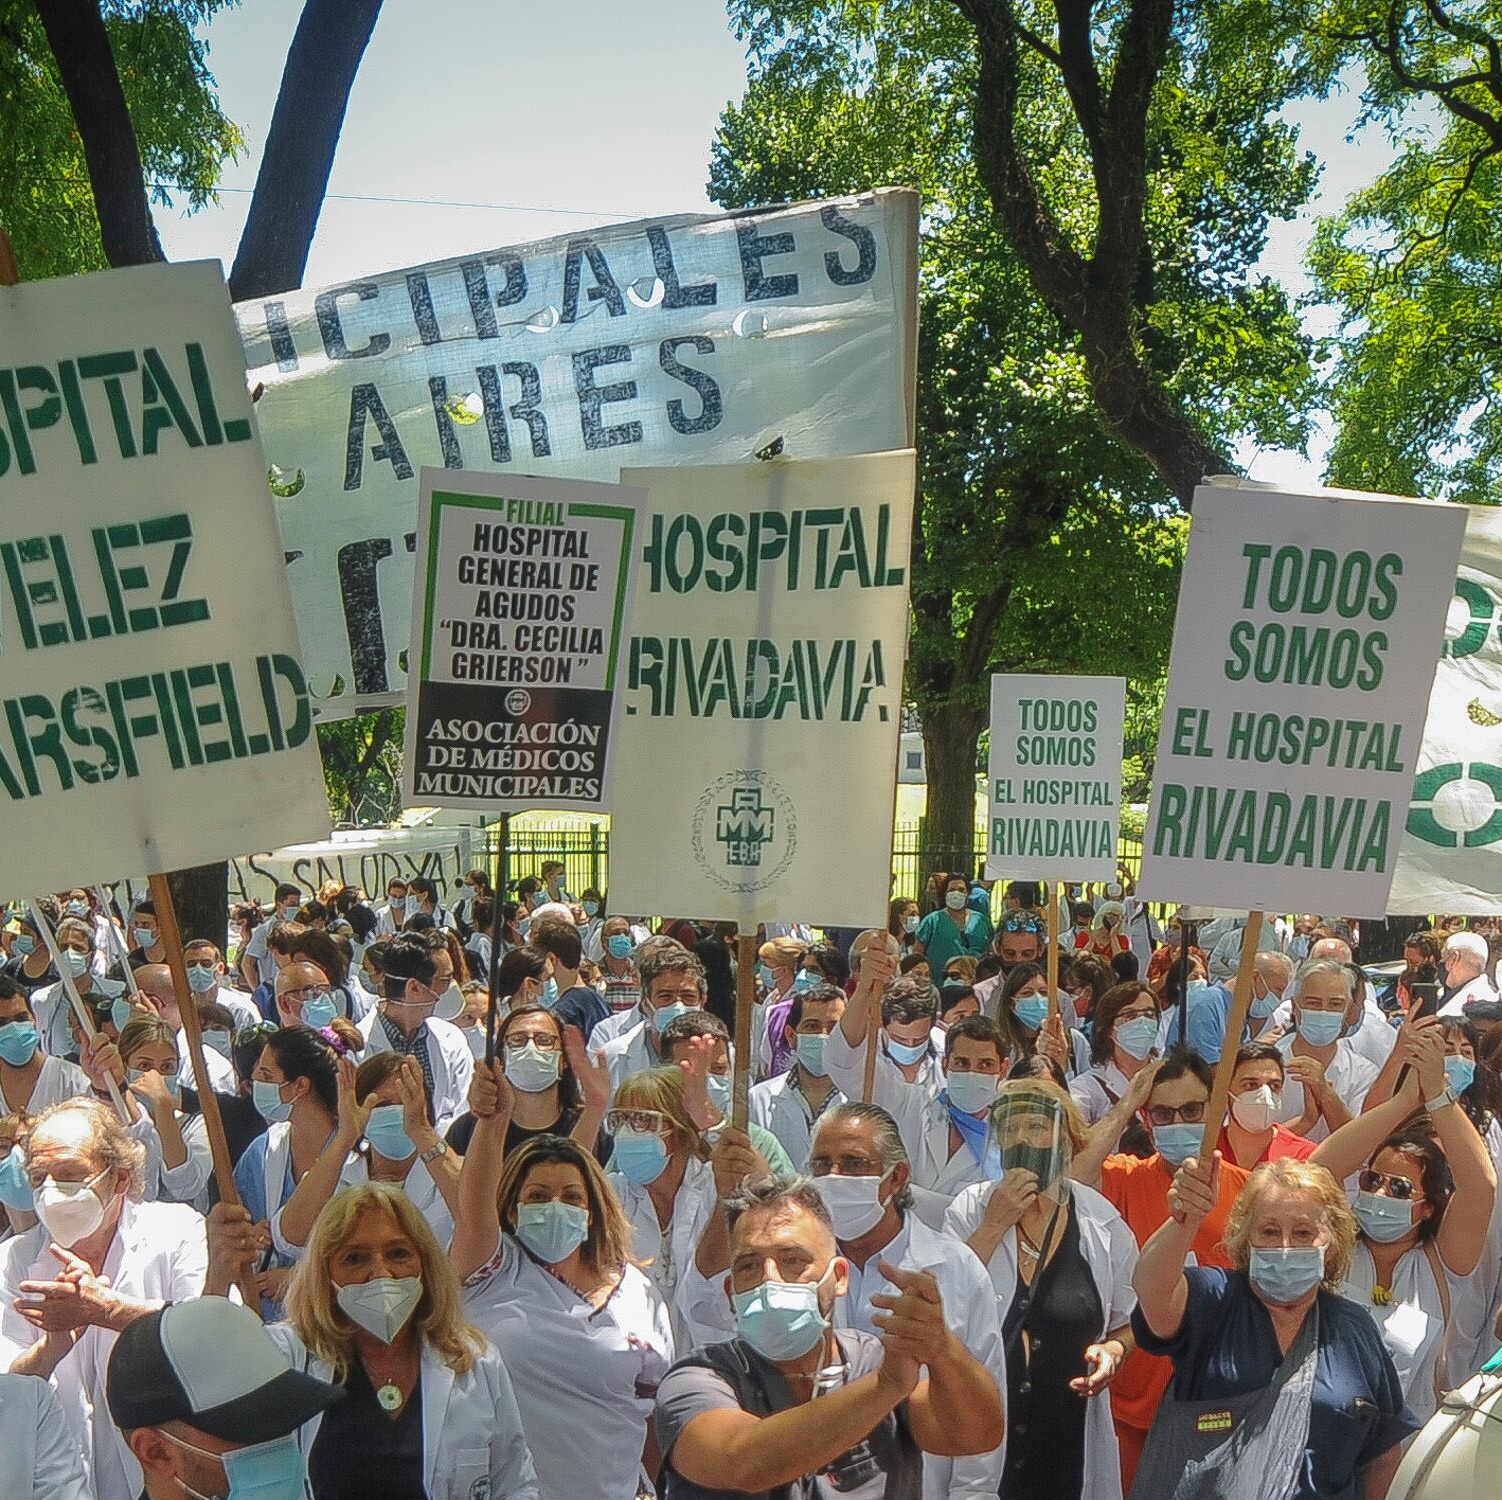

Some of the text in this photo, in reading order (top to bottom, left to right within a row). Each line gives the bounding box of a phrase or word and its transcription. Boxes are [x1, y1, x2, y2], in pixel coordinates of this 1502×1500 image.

[342, 334, 725, 492] AIRES
[506, 498, 566, 526] FILIAL
[473, 523, 590, 559] HOSPITAL
[458, 555, 600, 592] GENERAL DE
[1242, 543, 1404, 621] TODOS
[475, 590, 577, 622] AGUDOS
[515, 624, 604, 655] CECILIA
[1224, 620, 1388, 691] SOMOS
[626, 636, 890, 722] RIVADAVIA
[426, 718, 602, 747] ASOCIACIÓN
[1018, 698, 1098, 733] TODOS
[1016, 735, 1096, 767] SOMOS
[1171, 707, 1405, 773] EL HOSPITAL
[427, 746, 595, 772] DE MÉDICOS
[418, 772, 600, 799] MUNICIPALES
[995, 779, 1114, 806] EL HOSPITAL
[991, 817, 1112, 859] RIVADAVIA
[1152, 783, 1392, 874] RIVADAVIA
